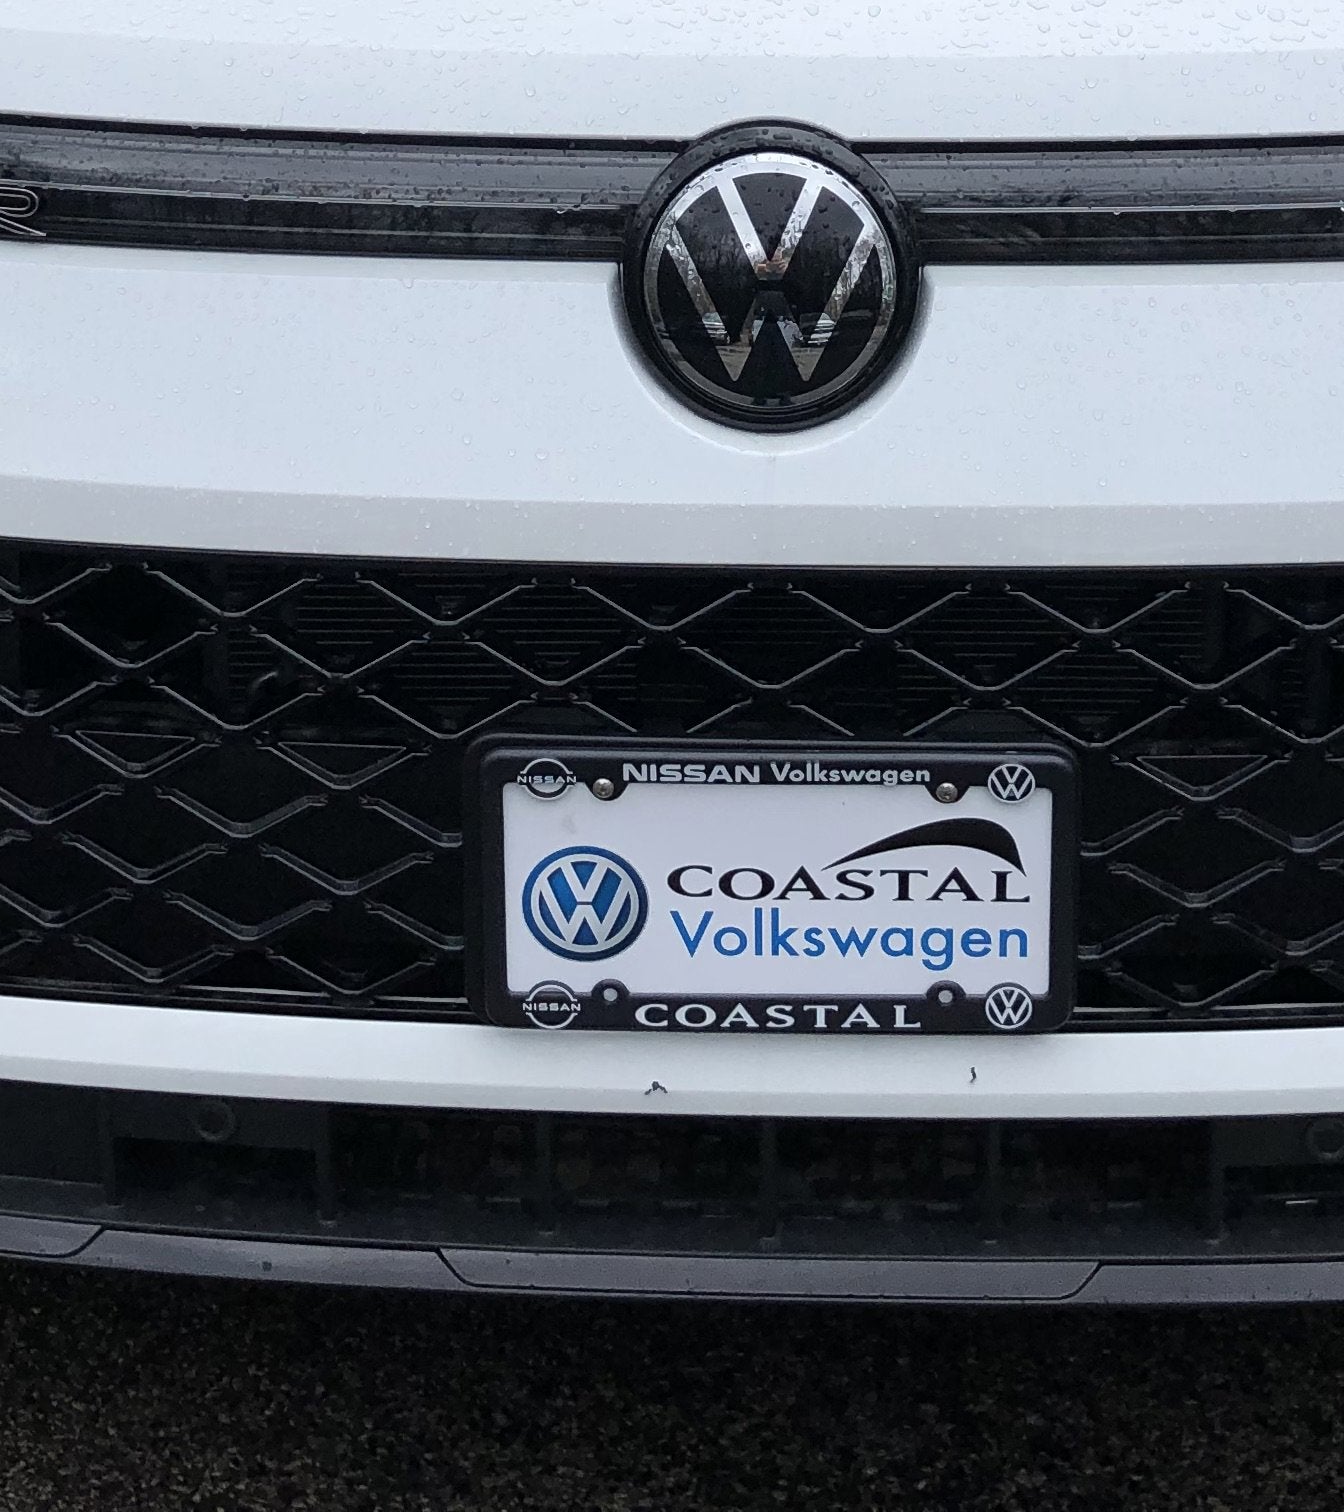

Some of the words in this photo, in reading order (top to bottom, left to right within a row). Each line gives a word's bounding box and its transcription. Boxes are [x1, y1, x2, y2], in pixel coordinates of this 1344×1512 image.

[516, 774, 577, 785] NISSAN
[622, 763, 760, 783] NISSAN
[771, 762, 931, 786] Volkswagen
[667, 865, 1031, 903] COASTAL
[669, 907, 1029, 972] Volkswagen
[522, 1002, 582, 1012] NISSAN
[634, 1003, 921, 1028] COASTAL
